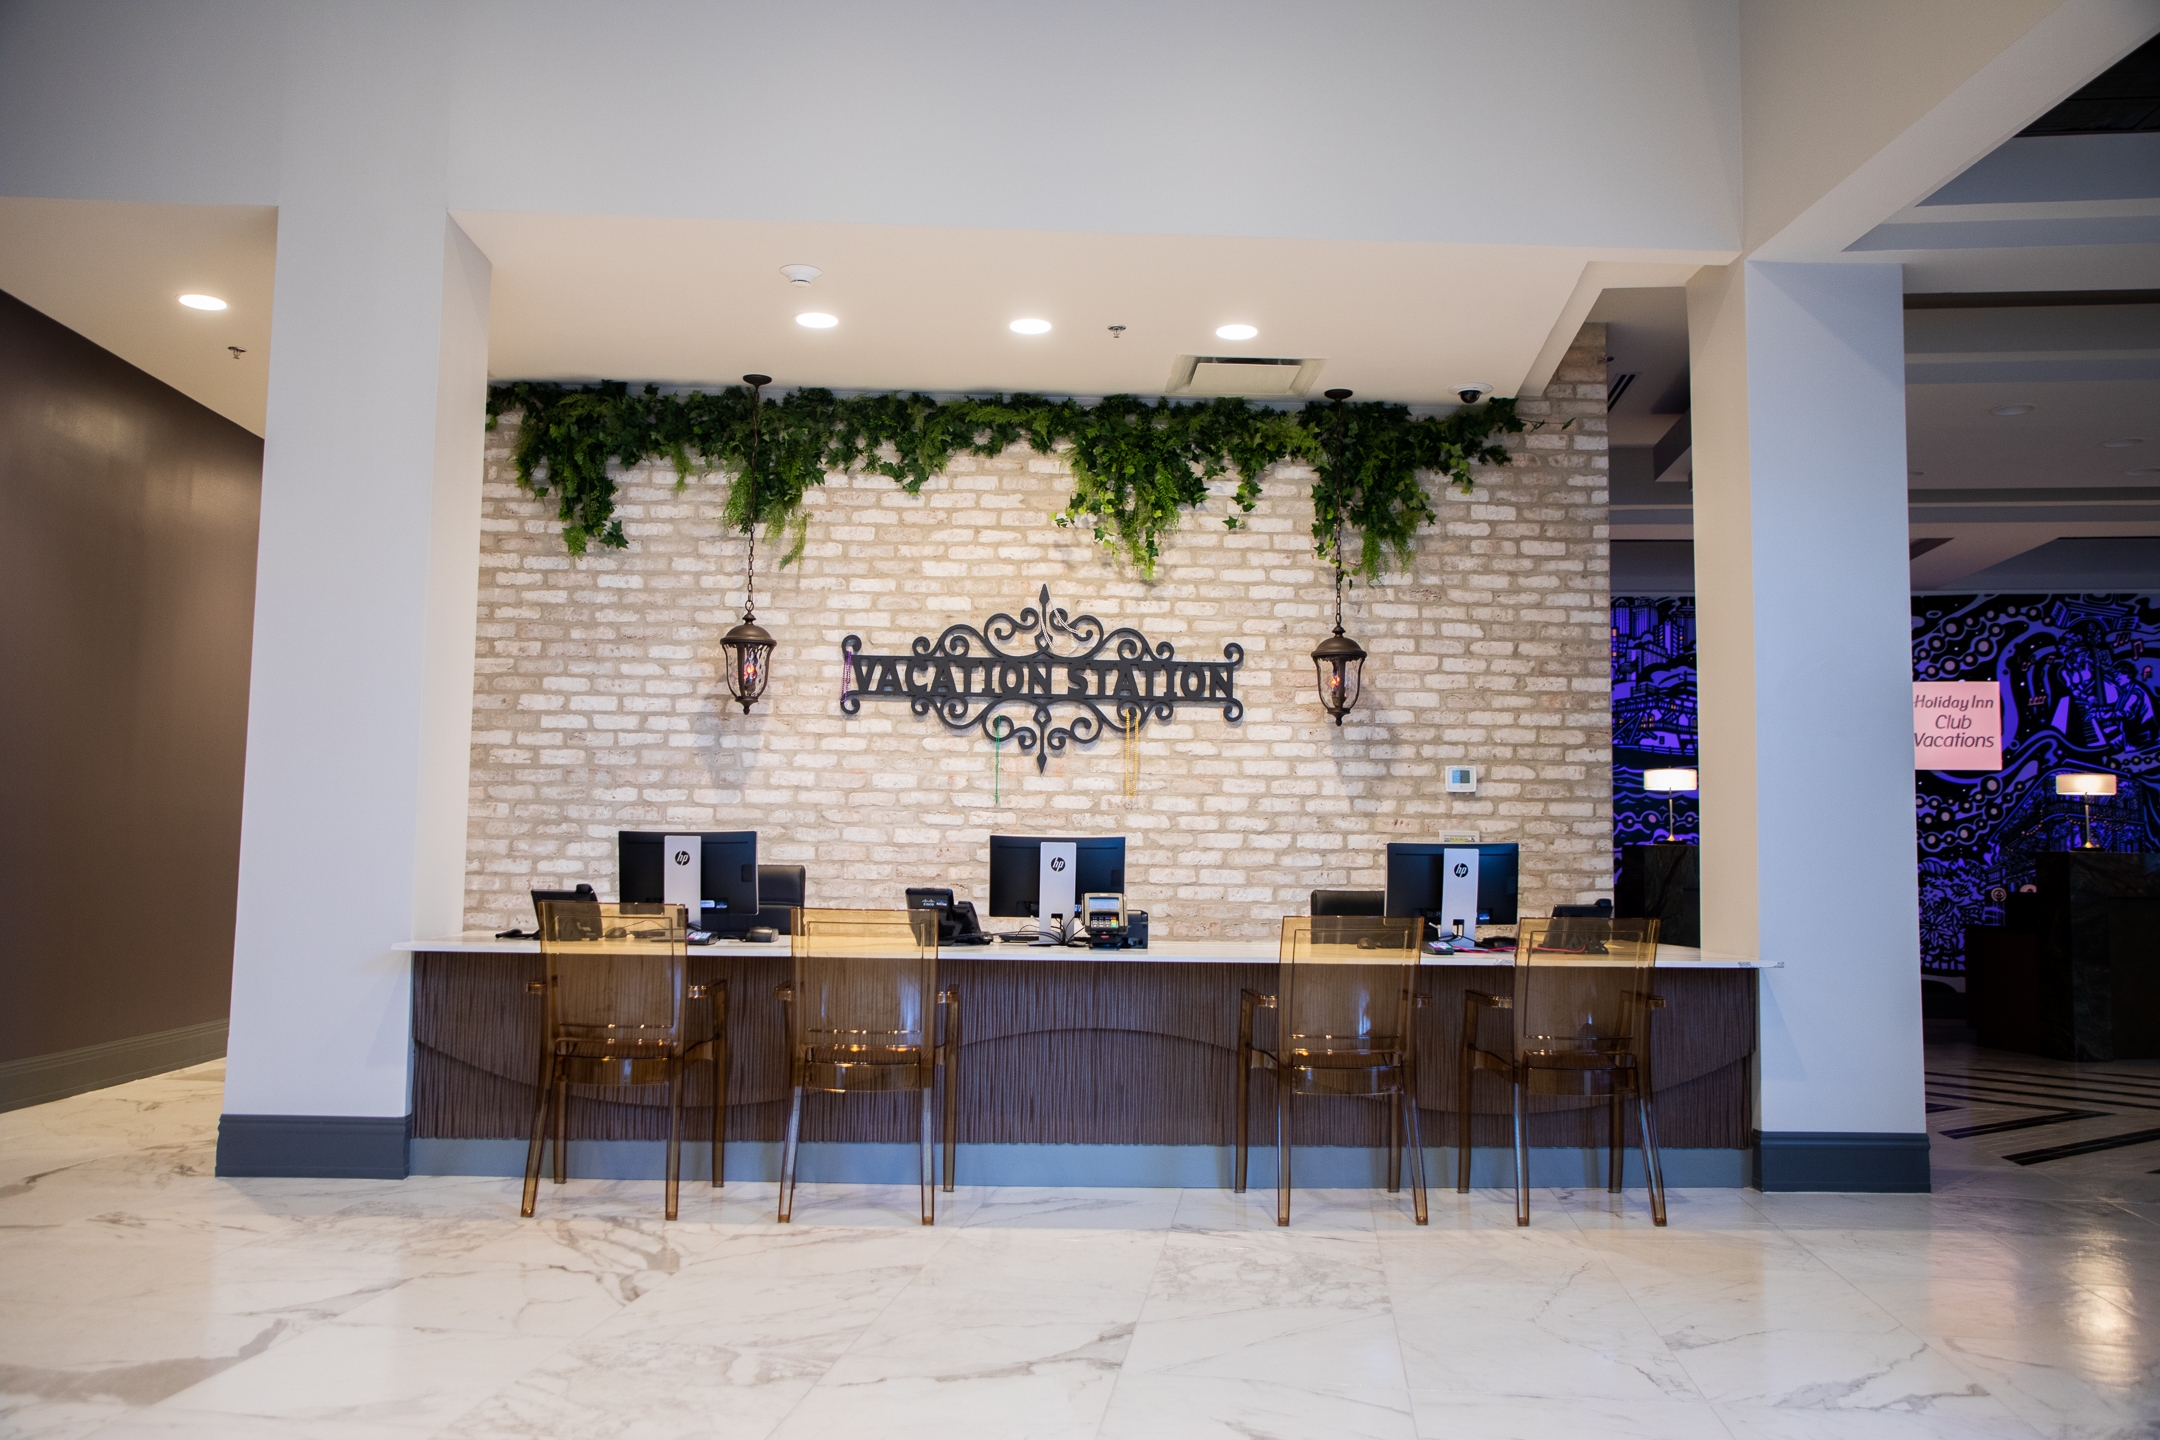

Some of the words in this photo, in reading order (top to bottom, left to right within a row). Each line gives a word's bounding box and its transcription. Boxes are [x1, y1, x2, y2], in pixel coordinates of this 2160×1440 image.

[852, 656, 1052, 698] VACATION
[1067, 661, 1234, 701] STATION
[1914, 695, 1969, 711] Holiday
[1971, 695, 1994, 709] Inn
[1935, 714, 1972, 729] Club
[1914, 732, 1994, 748] Vacations
[675, 851, 690, 866] hp
[1051, 857, 1066, 872] hp
[1454, 863, 1468, 878] hp
